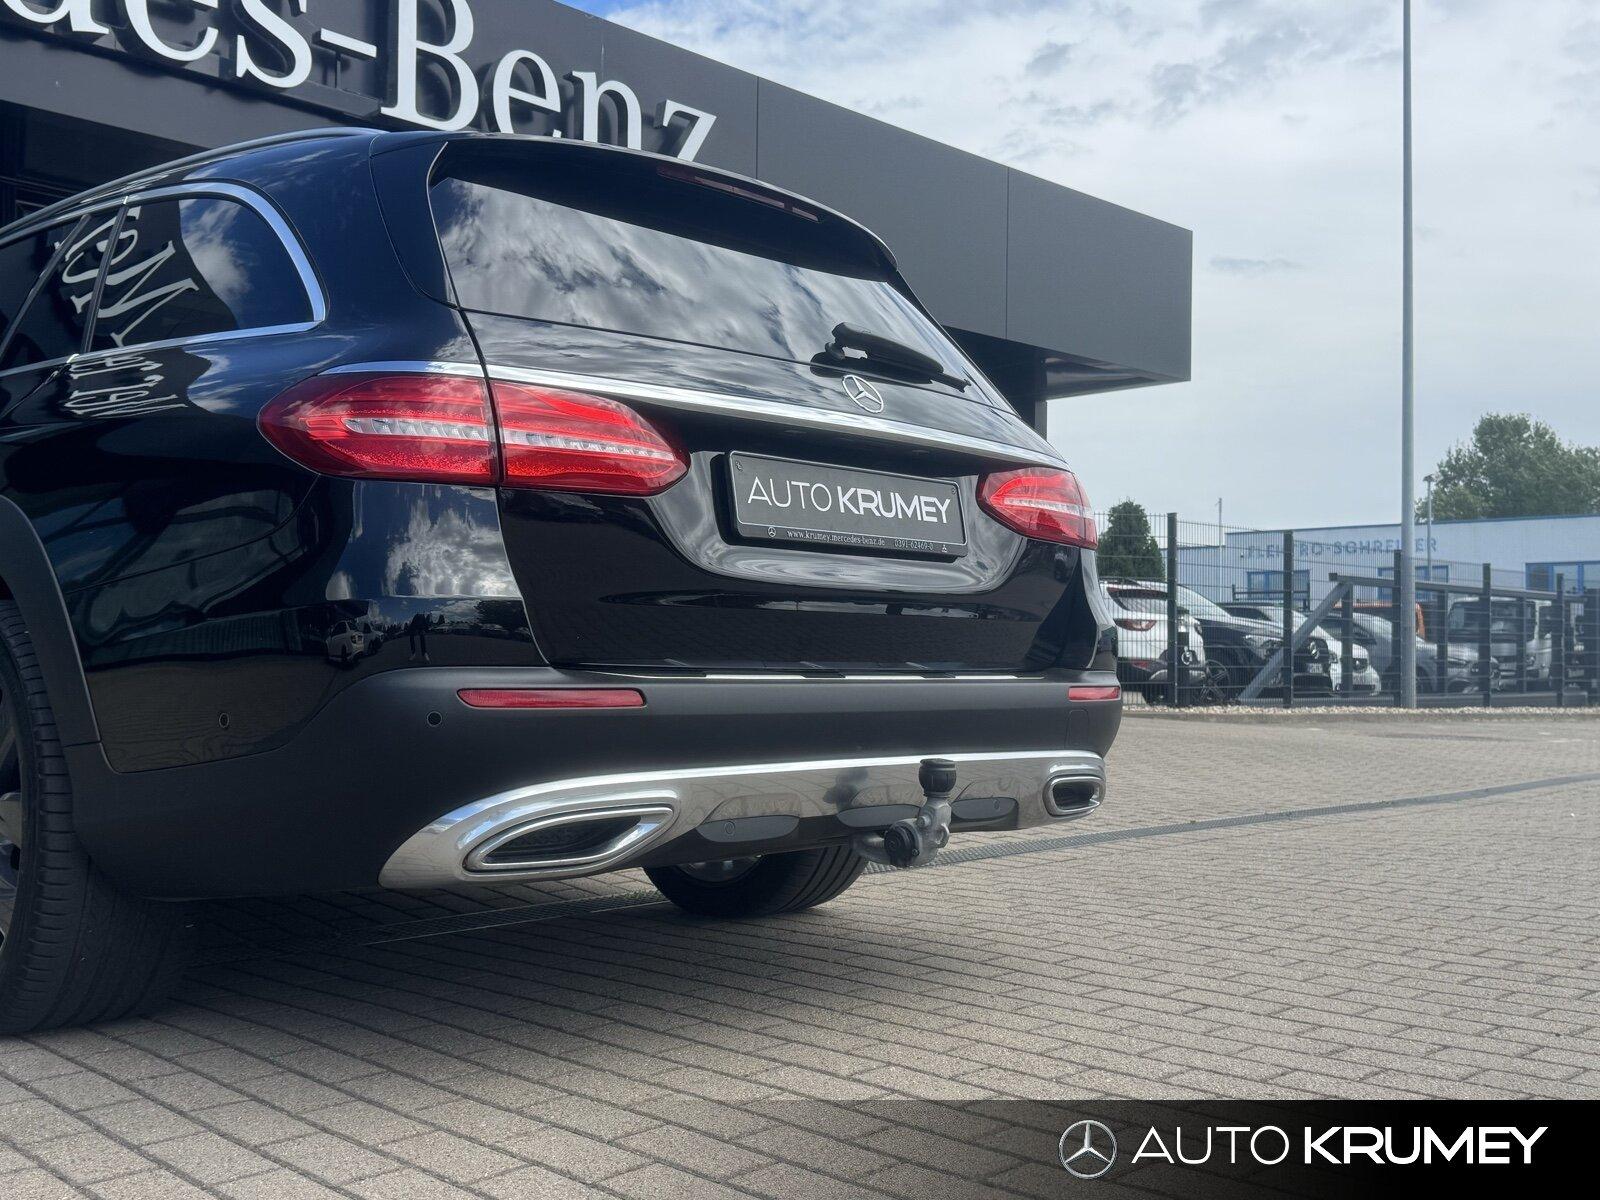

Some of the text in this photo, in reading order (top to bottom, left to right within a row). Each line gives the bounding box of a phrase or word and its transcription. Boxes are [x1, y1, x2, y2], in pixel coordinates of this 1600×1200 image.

[747, 476, 951, 524] AUTO KRUMEY
[786, 529, 886, 547] www.krumey.mercedes-benz.de
